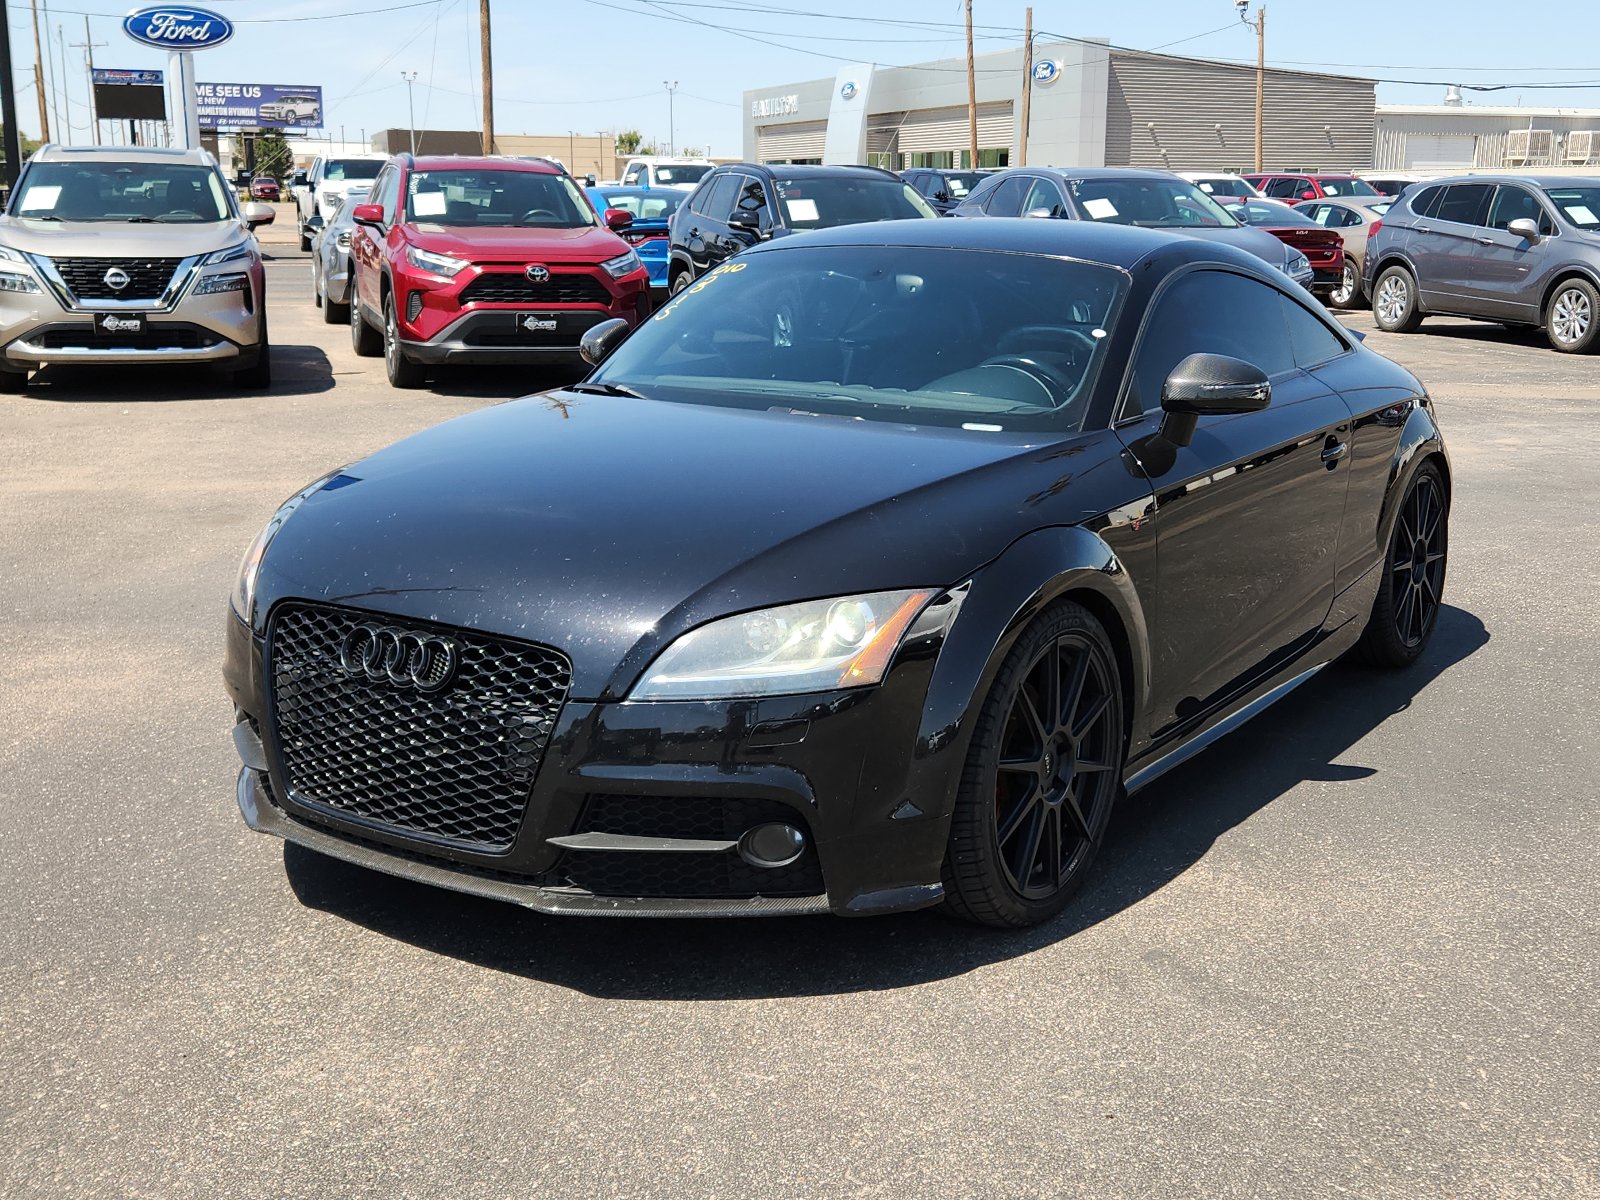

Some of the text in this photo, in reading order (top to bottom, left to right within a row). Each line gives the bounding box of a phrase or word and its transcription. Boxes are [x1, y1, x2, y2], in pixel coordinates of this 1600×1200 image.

[146, 12, 211, 41] Ford
[216, 86, 240, 98] SEE
[243, 87, 261, 98] US
[204, 97, 226, 105] NEW
[752, 94, 799, 117] HAMILTON
[228, 107, 257, 117] HYUNDAI
